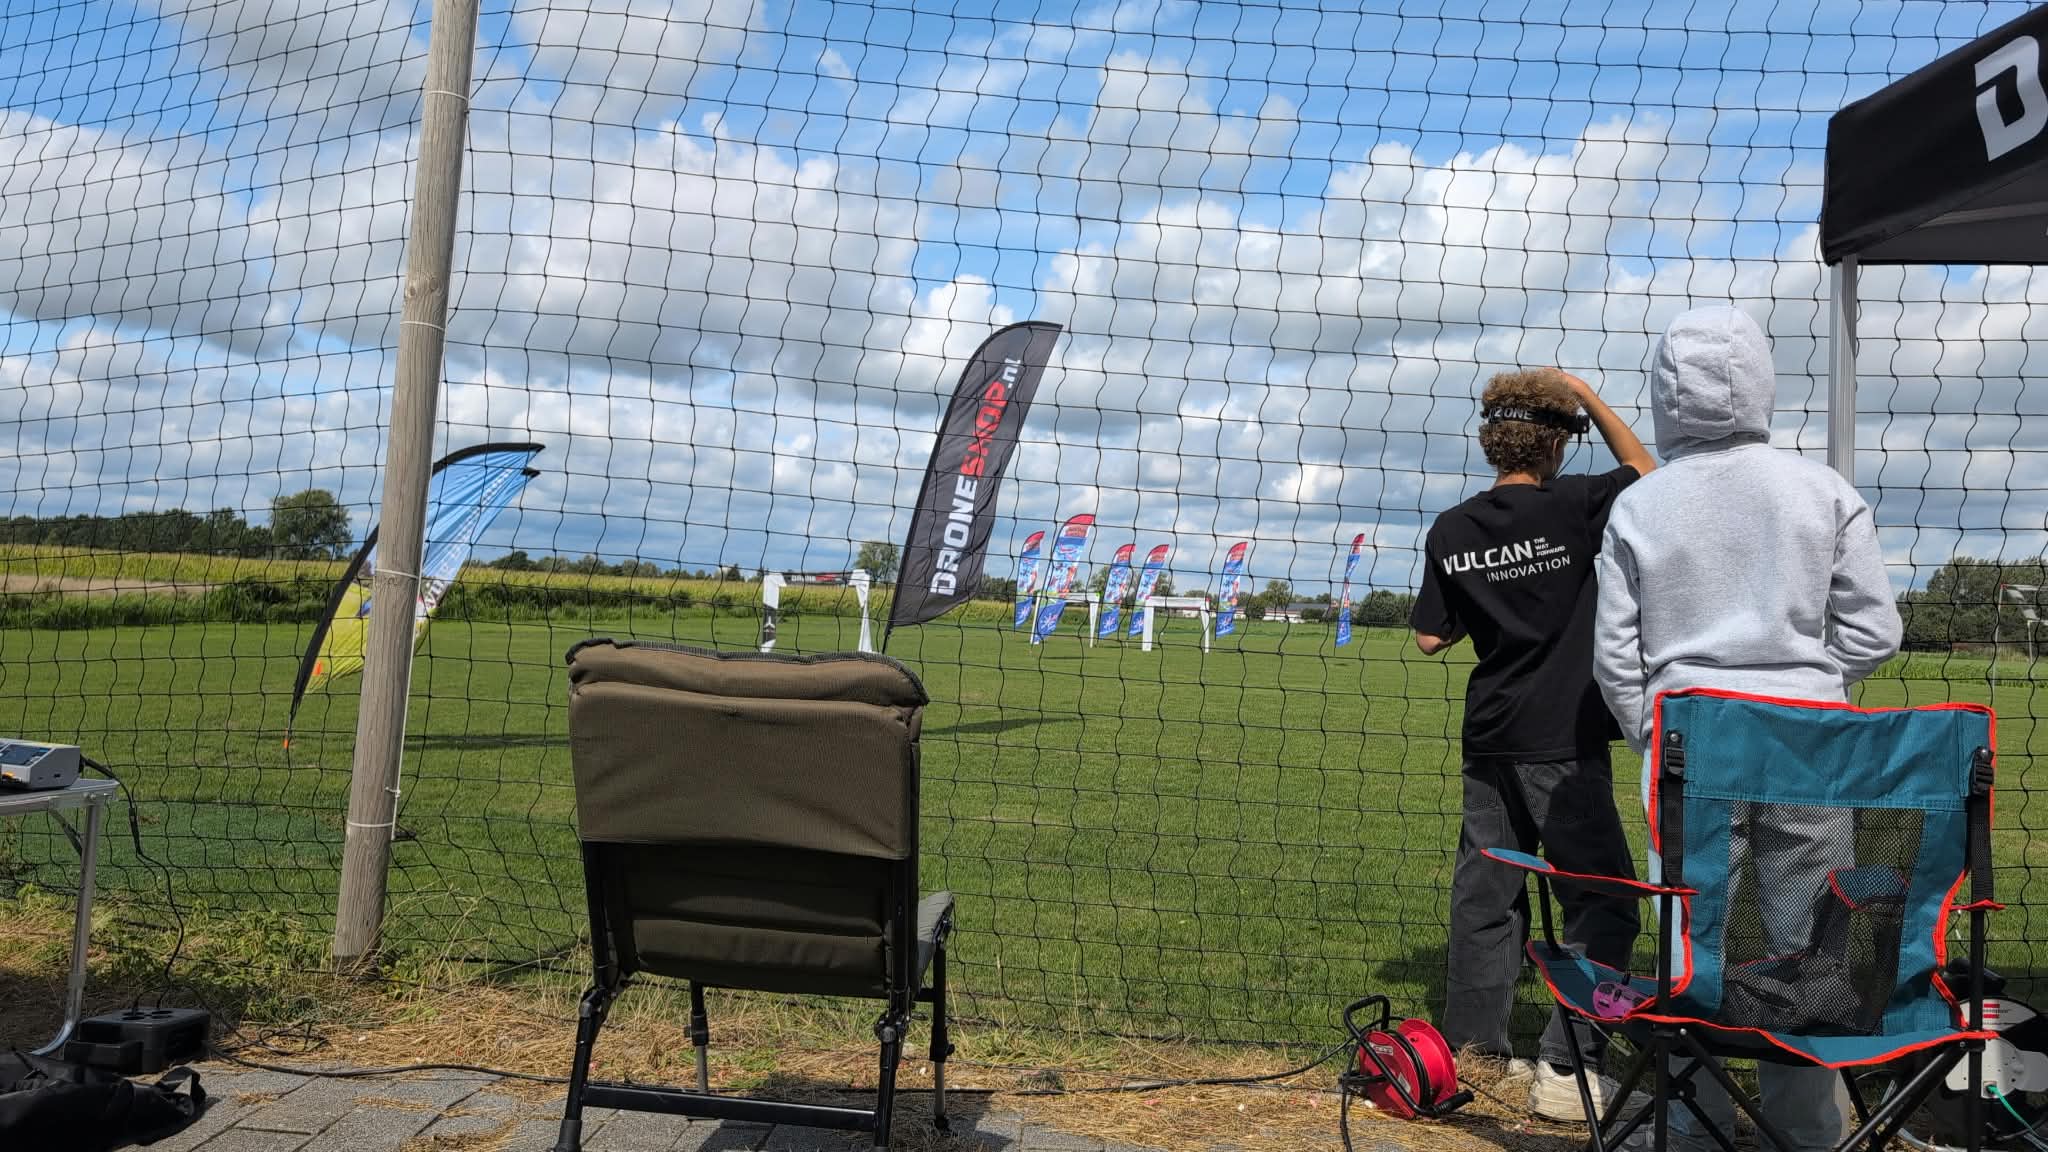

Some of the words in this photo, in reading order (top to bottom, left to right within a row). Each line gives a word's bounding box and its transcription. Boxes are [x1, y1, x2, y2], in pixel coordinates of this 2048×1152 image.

[930, 357, 1022, 596] DRONESHOP.nl
[1443, 540, 1533, 575] VULCAN
[1487, 555, 1570, 582] INNOVATION
